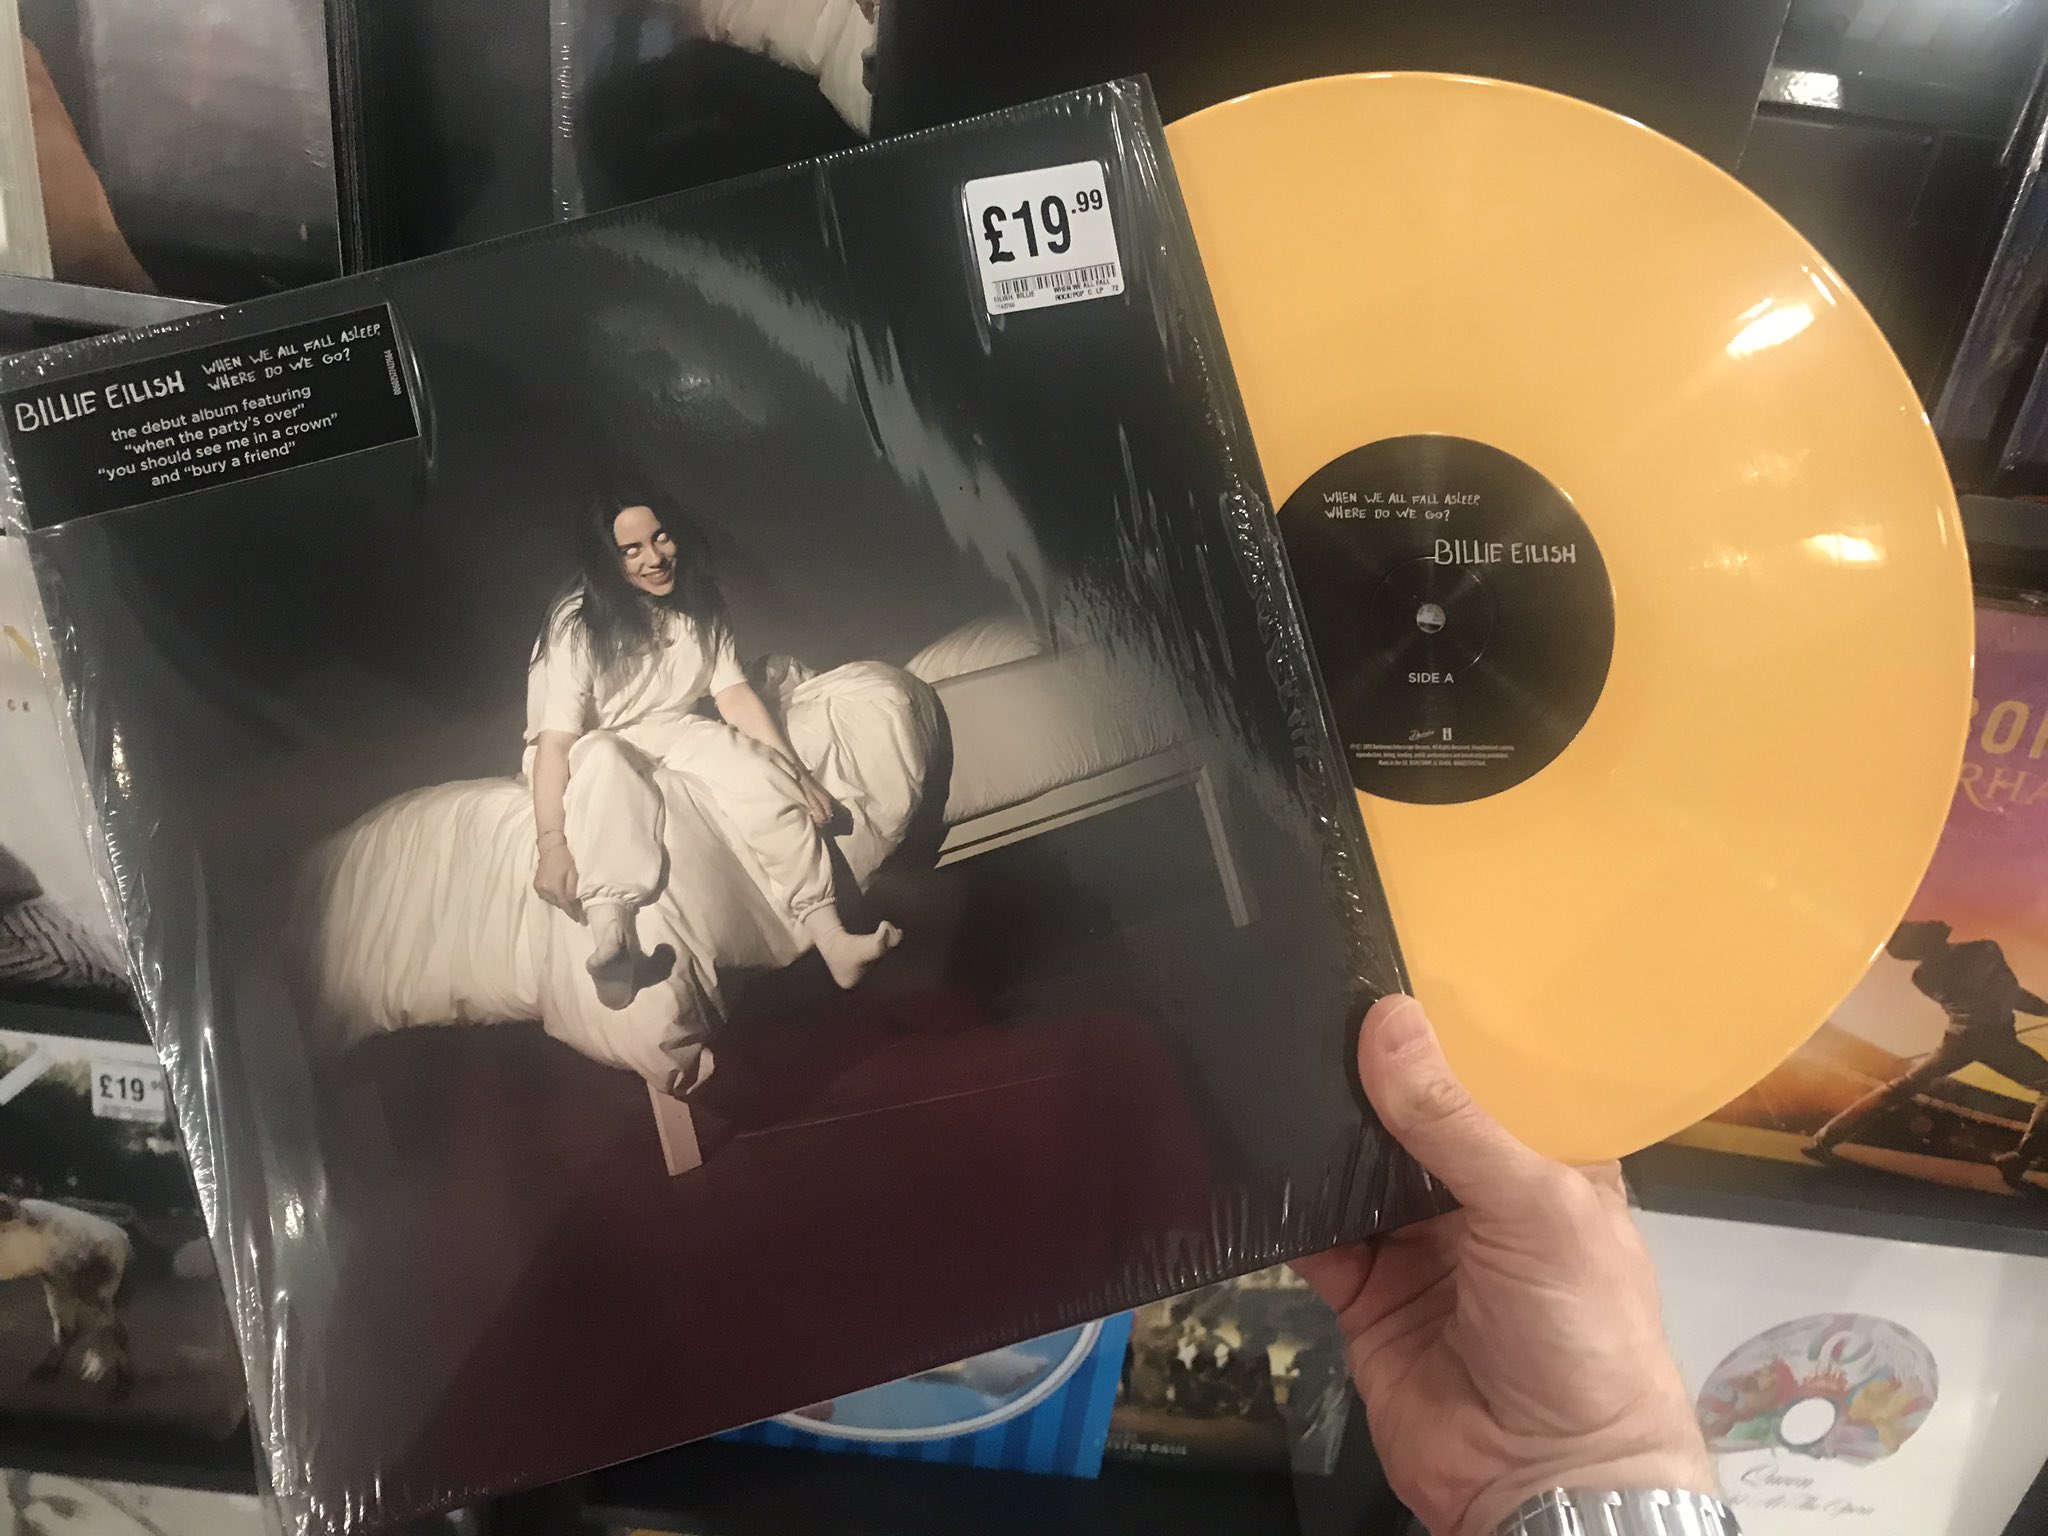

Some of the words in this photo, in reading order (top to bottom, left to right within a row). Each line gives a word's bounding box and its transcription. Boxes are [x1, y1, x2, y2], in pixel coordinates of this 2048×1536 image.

[201, 355, 242, 376] WHEN
[249, 348, 274, 364] WE
[277, 344, 299, 359] ALL
[303, 334, 336, 352] FALL
[207, 370, 256, 391] WHERE
[264, 366, 283, 379] DO
[289, 357, 314, 371] WE
[322, 347, 351, 365] GO?
[15, 390, 97, 432] BILLIE
[104, 370, 185, 409] EILISH
[111, 426, 137, 442] the
[141, 414, 187, 435] debut
[191, 404, 239, 423] album
[242, 385, 312, 411] featuring
[140, 449, 191, 471] should
[196, 444, 222, 458] see
[226, 437, 250, 451] me
[253, 430, 268, 444] in
[271, 429, 281, 440] a
[178, 430, 204, 445] the
[151, 468, 181, 487] and
[231, 456, 241, 467] a
[1323, 491, 1357, 504] WHEN
[1364, 492, 1385, 504] WE
[1388, 492, 1406, 504] ALL
[1412, 494, 1439, 505] FALL
[1324, 506, 1367, 519] WHERE
[1375, 509, 1390, 519] DO
[1396, 509, 1417, 519] WE
[1425, 508, 1450, 521] GO?
[1434, 538, 1504, 565] BILLIE
[1511, 542, 1576, 564] EILISH
[1408, 672, 1440, 684] SIDE
[1443, 672, 1455, 684] A
